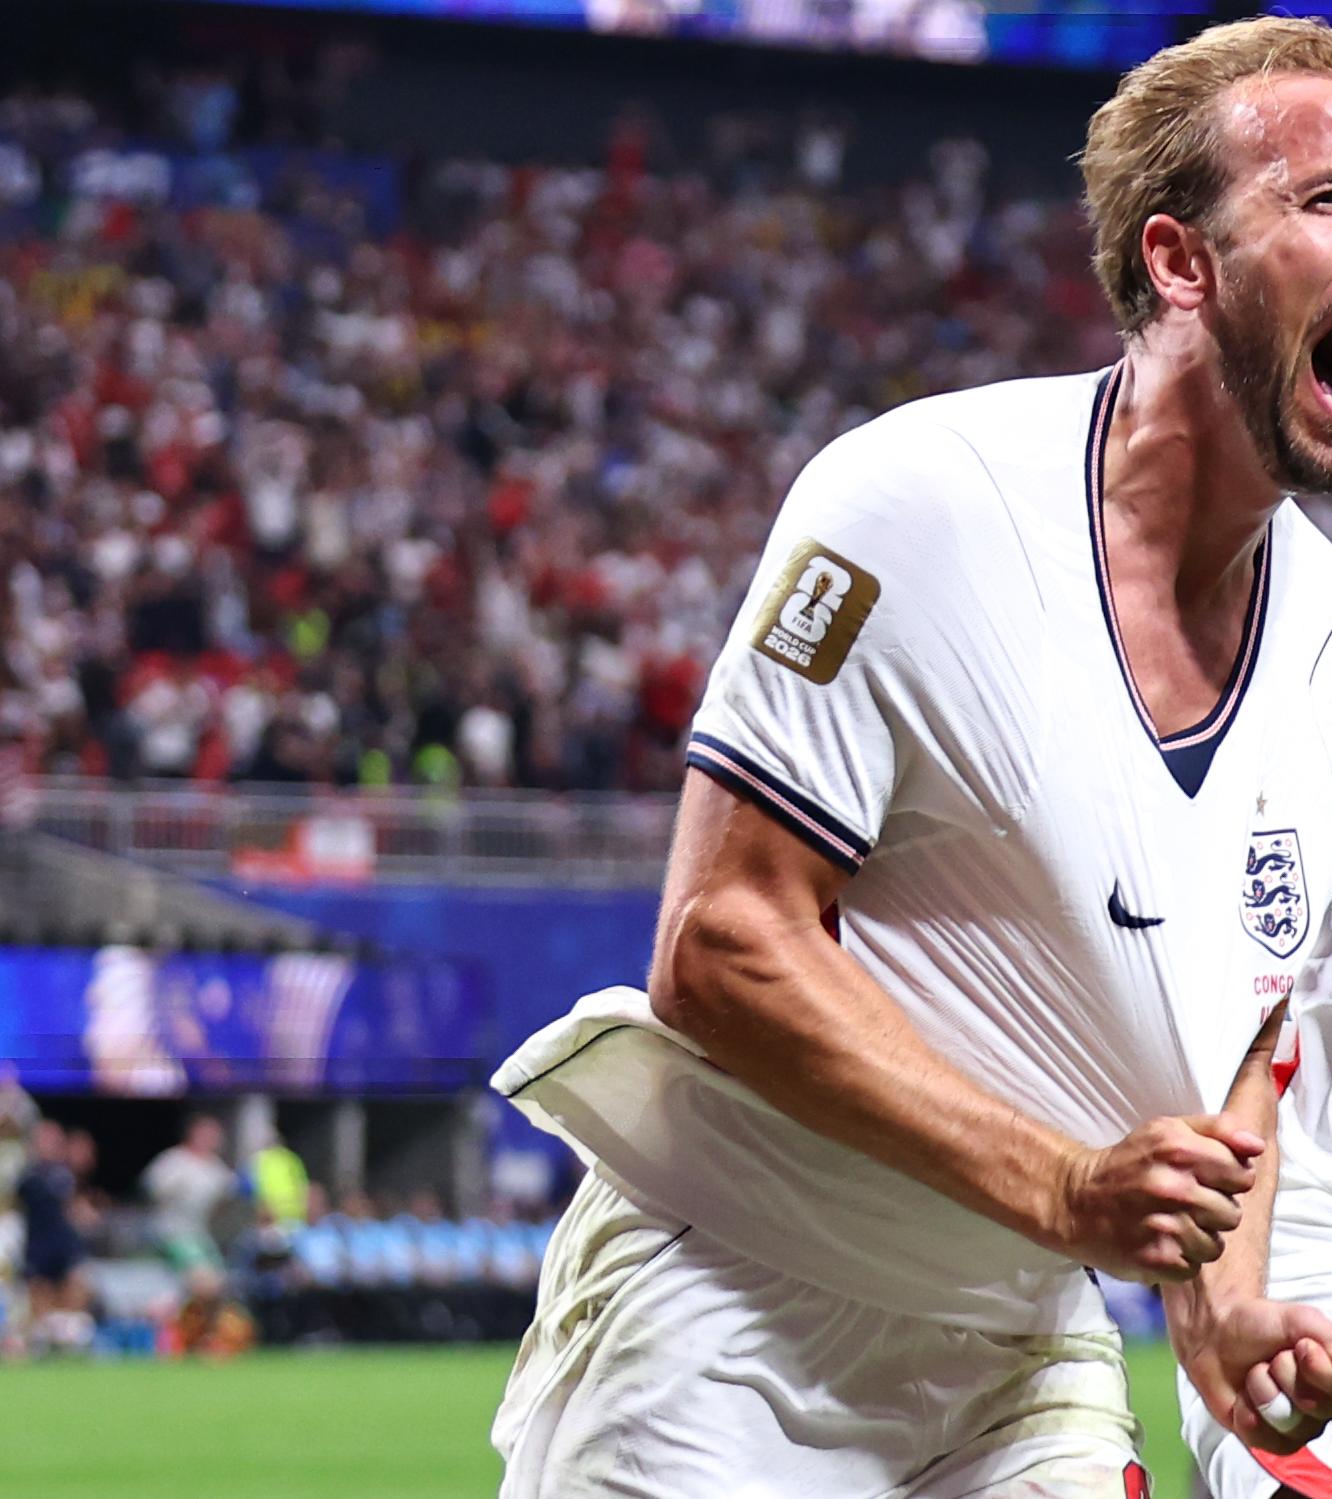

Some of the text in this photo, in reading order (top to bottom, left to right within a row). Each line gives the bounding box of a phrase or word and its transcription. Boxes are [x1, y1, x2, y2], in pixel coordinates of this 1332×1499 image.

[791, 616, 812, 633] FIFA
[763, 634, 812, 667] 2026
[771, 625, 817, 656] WORLD CUP
